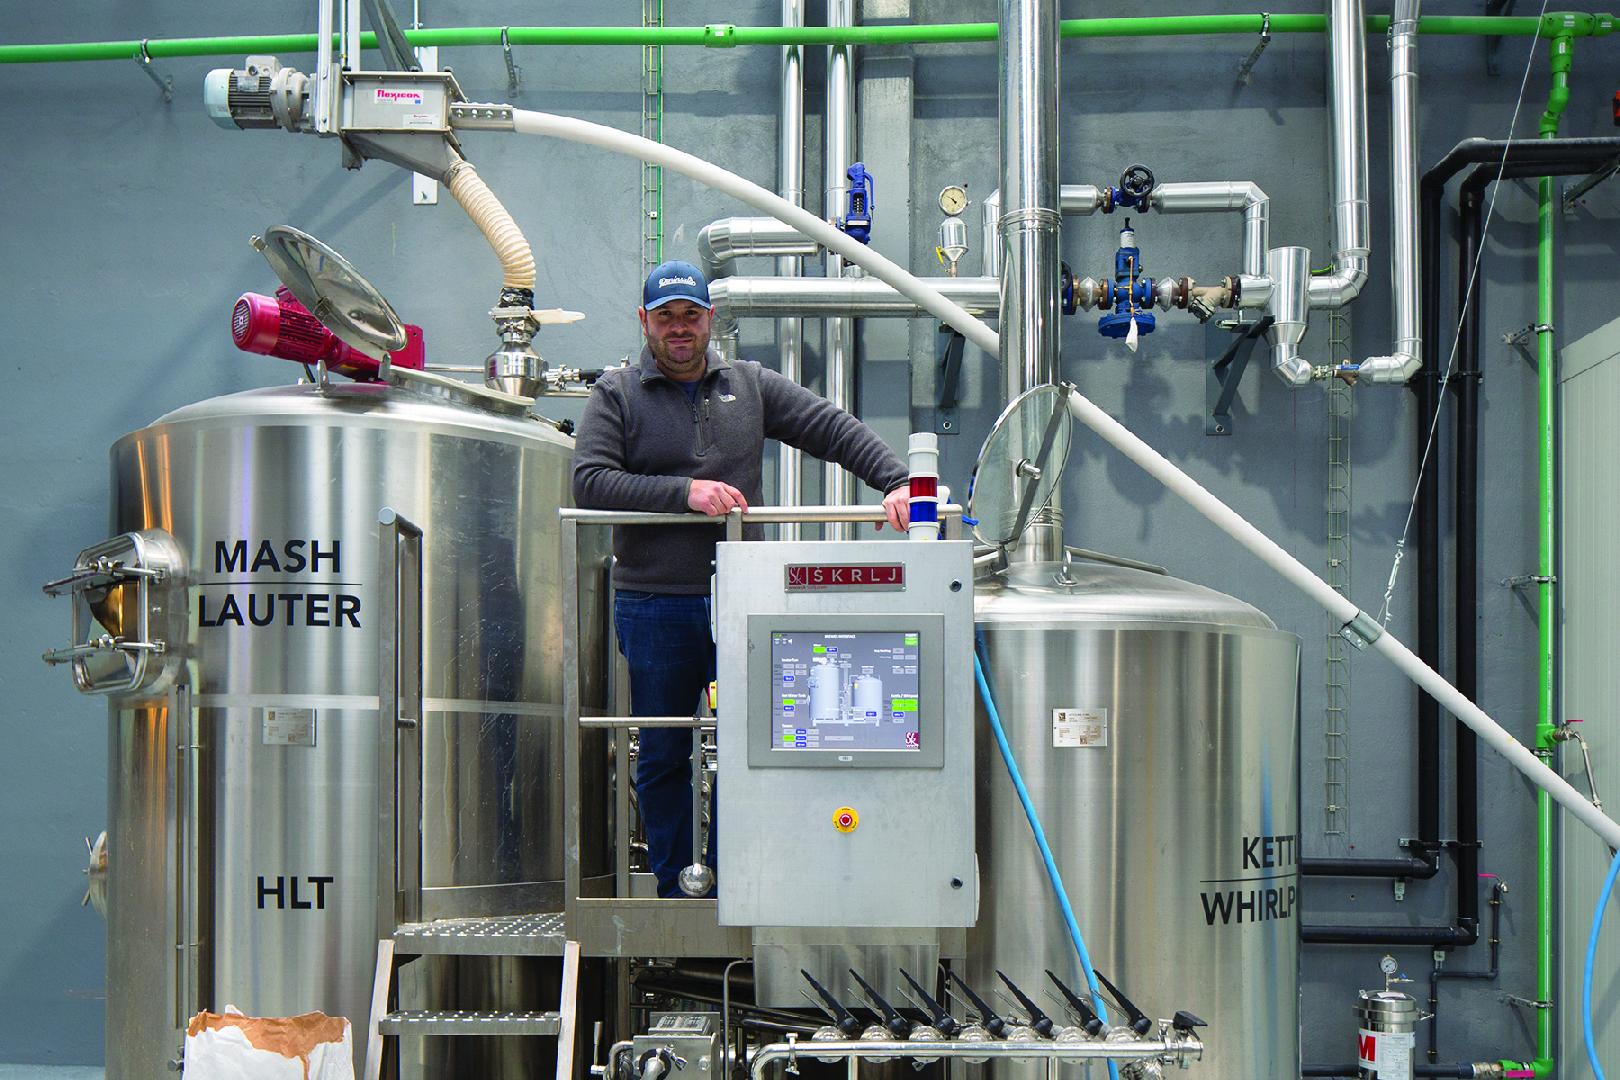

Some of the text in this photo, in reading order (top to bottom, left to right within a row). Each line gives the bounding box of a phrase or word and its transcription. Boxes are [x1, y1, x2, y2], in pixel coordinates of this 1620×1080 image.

[215, 540, 341, 573] MASH
[198, 593, 362, 628] LAUTER
[257, 876, 334, 909] HLT
[1200, 885, 1296, 925] WHIRLP
